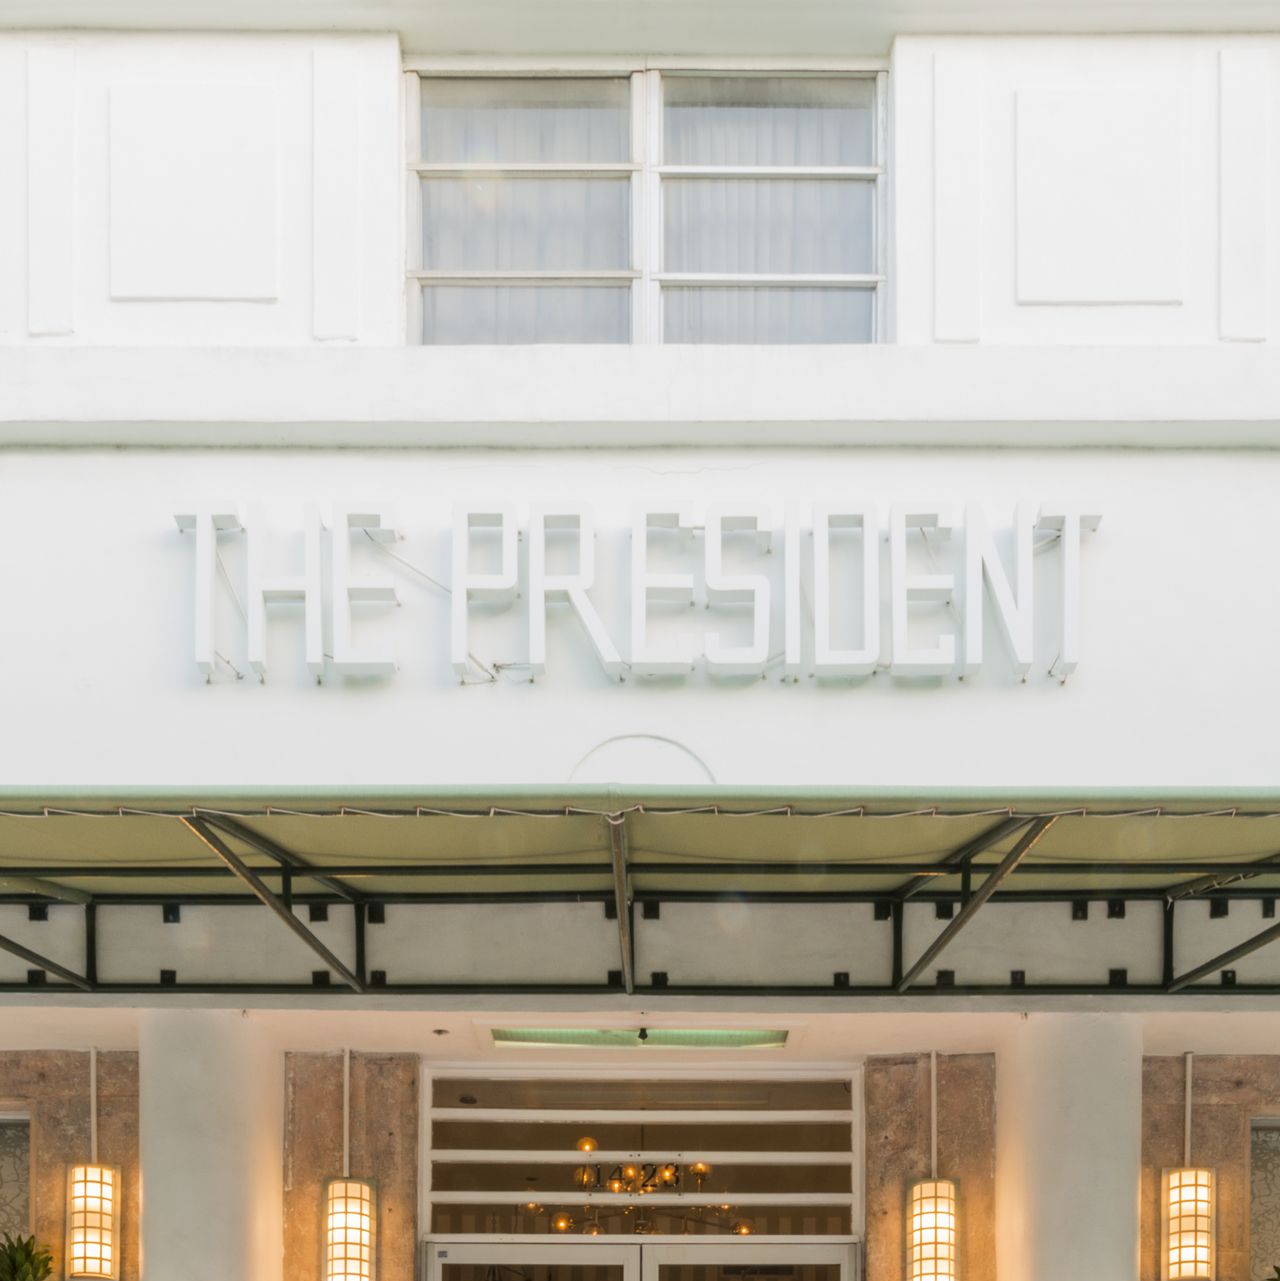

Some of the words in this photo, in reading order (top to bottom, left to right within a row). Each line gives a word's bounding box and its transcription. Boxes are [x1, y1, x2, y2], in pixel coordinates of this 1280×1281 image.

[173, 501, 402, 676] THE
[450, 499, 1104, 679] PRESIDENT
[592, 1163, 680, 1188] 1423
